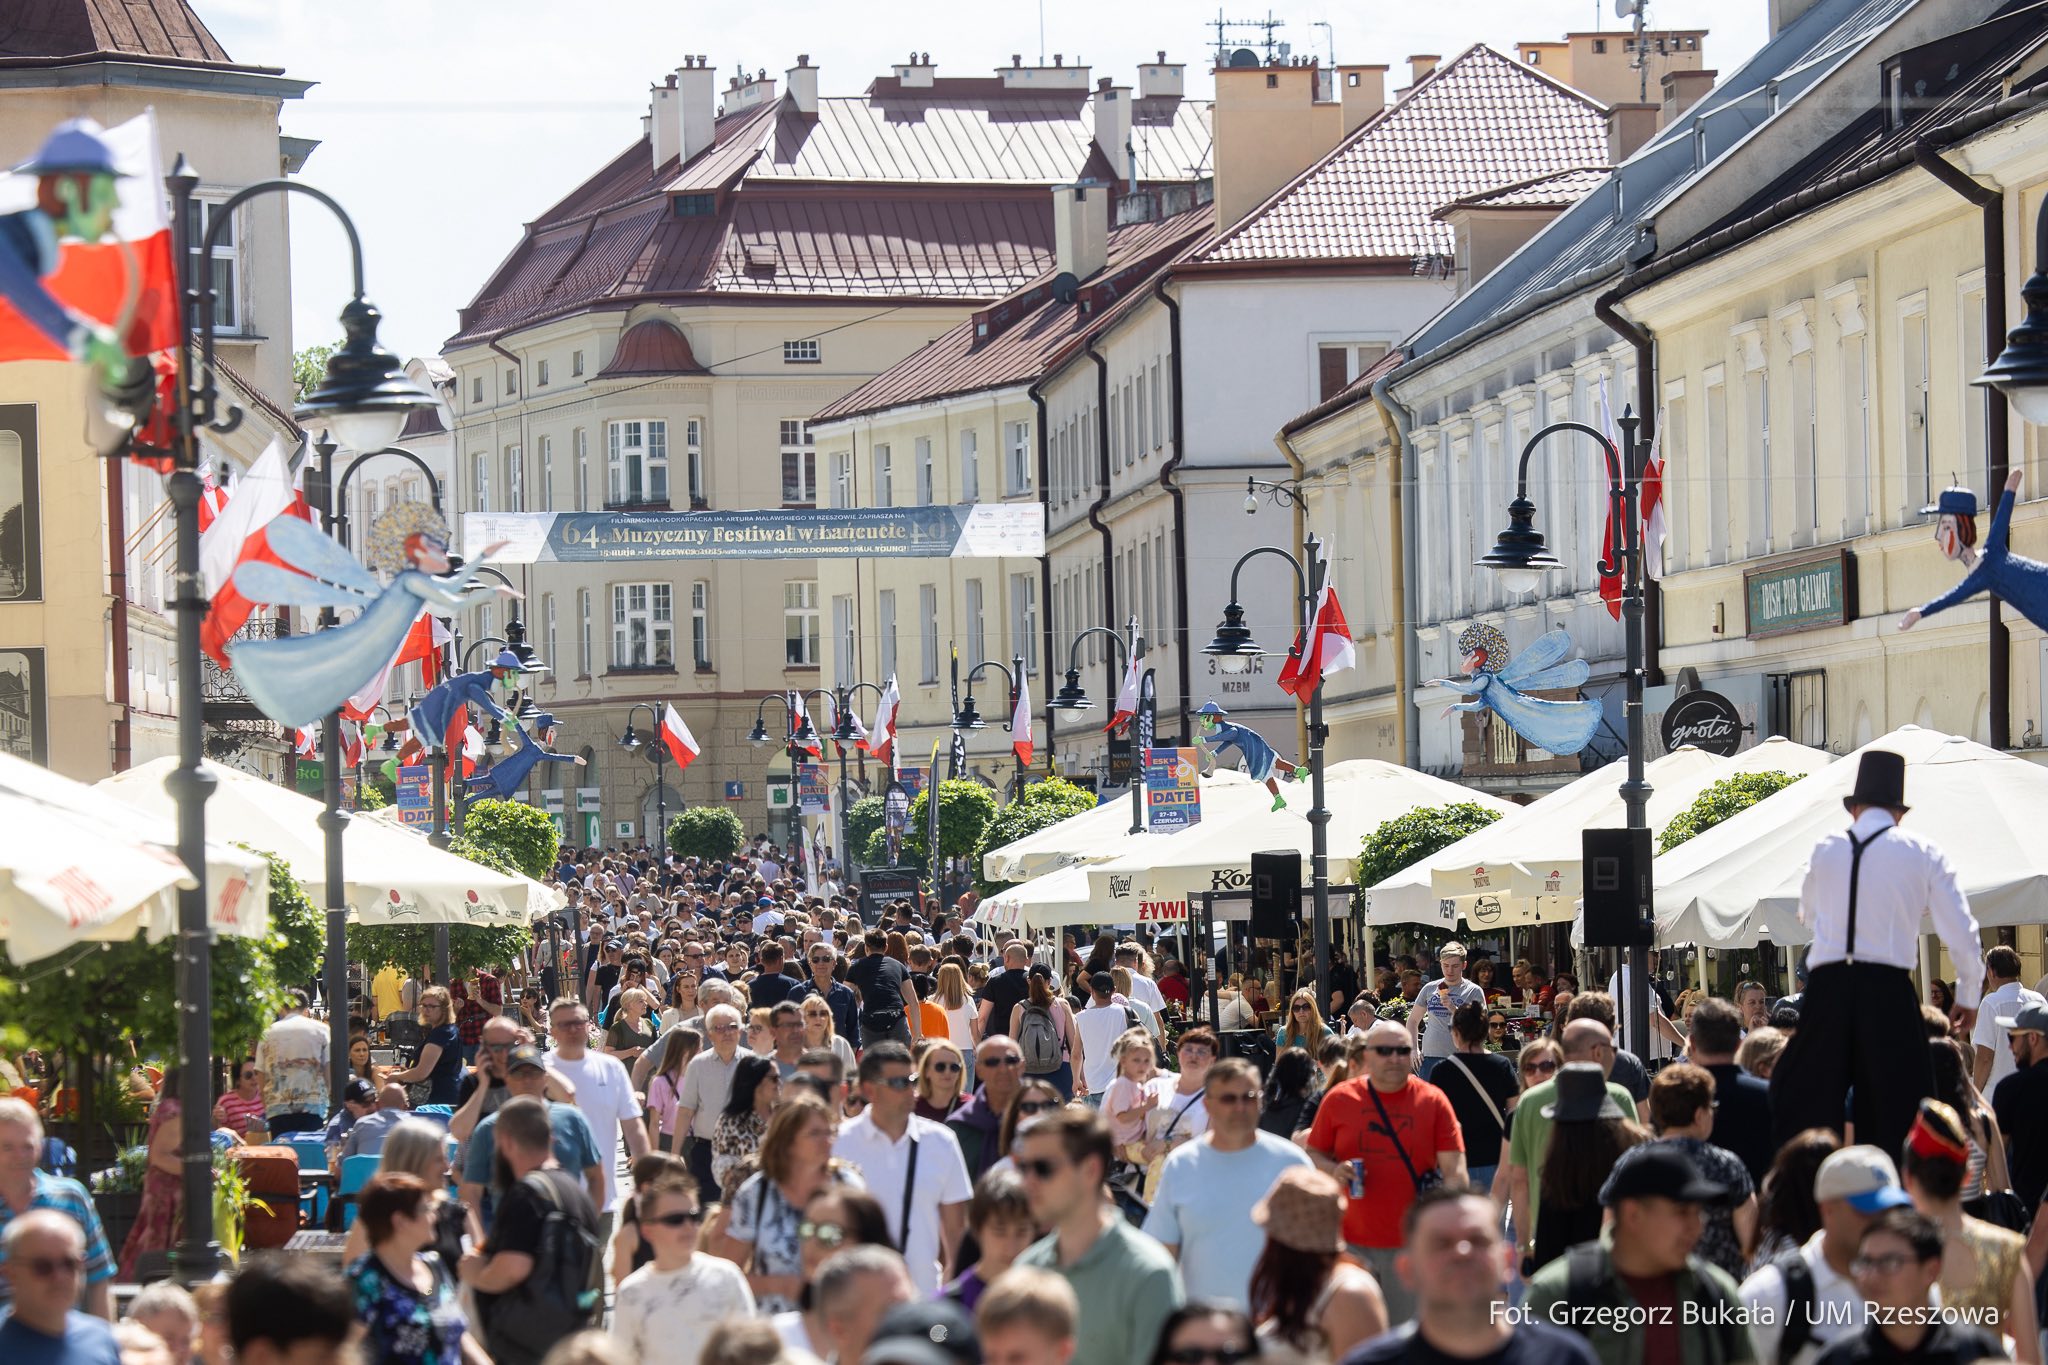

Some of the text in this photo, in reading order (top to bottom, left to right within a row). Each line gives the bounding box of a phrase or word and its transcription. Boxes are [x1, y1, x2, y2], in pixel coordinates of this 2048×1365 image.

[816, 513, 858, 521] RZESZOWIE
[562, 518, 906, 549] 64. Muzyczny Festiwal w Łańcucie
[611, 547, 636, 557] maja
[773, 546, 808, 554] PLACIDO
[1762, 572, 1831, 620] IRISH PUB GALWAY
[1208, 659, 1216, 675] 3
[1222, 682, 1250, 693] MZBM
[1670, 715, 1733, 749] grota
[732, 784, 738, 795] 1
[401, 798, 427, 806] SAVE
[1153, 791, 1194, 804] DATE
[404, 810, 433, 822] DAT
[1211, 869, 1252, 890] Koz
[1109, 875, 1132, 899] Kozel
[1139, 900, 1186, 920] ŻYWI
